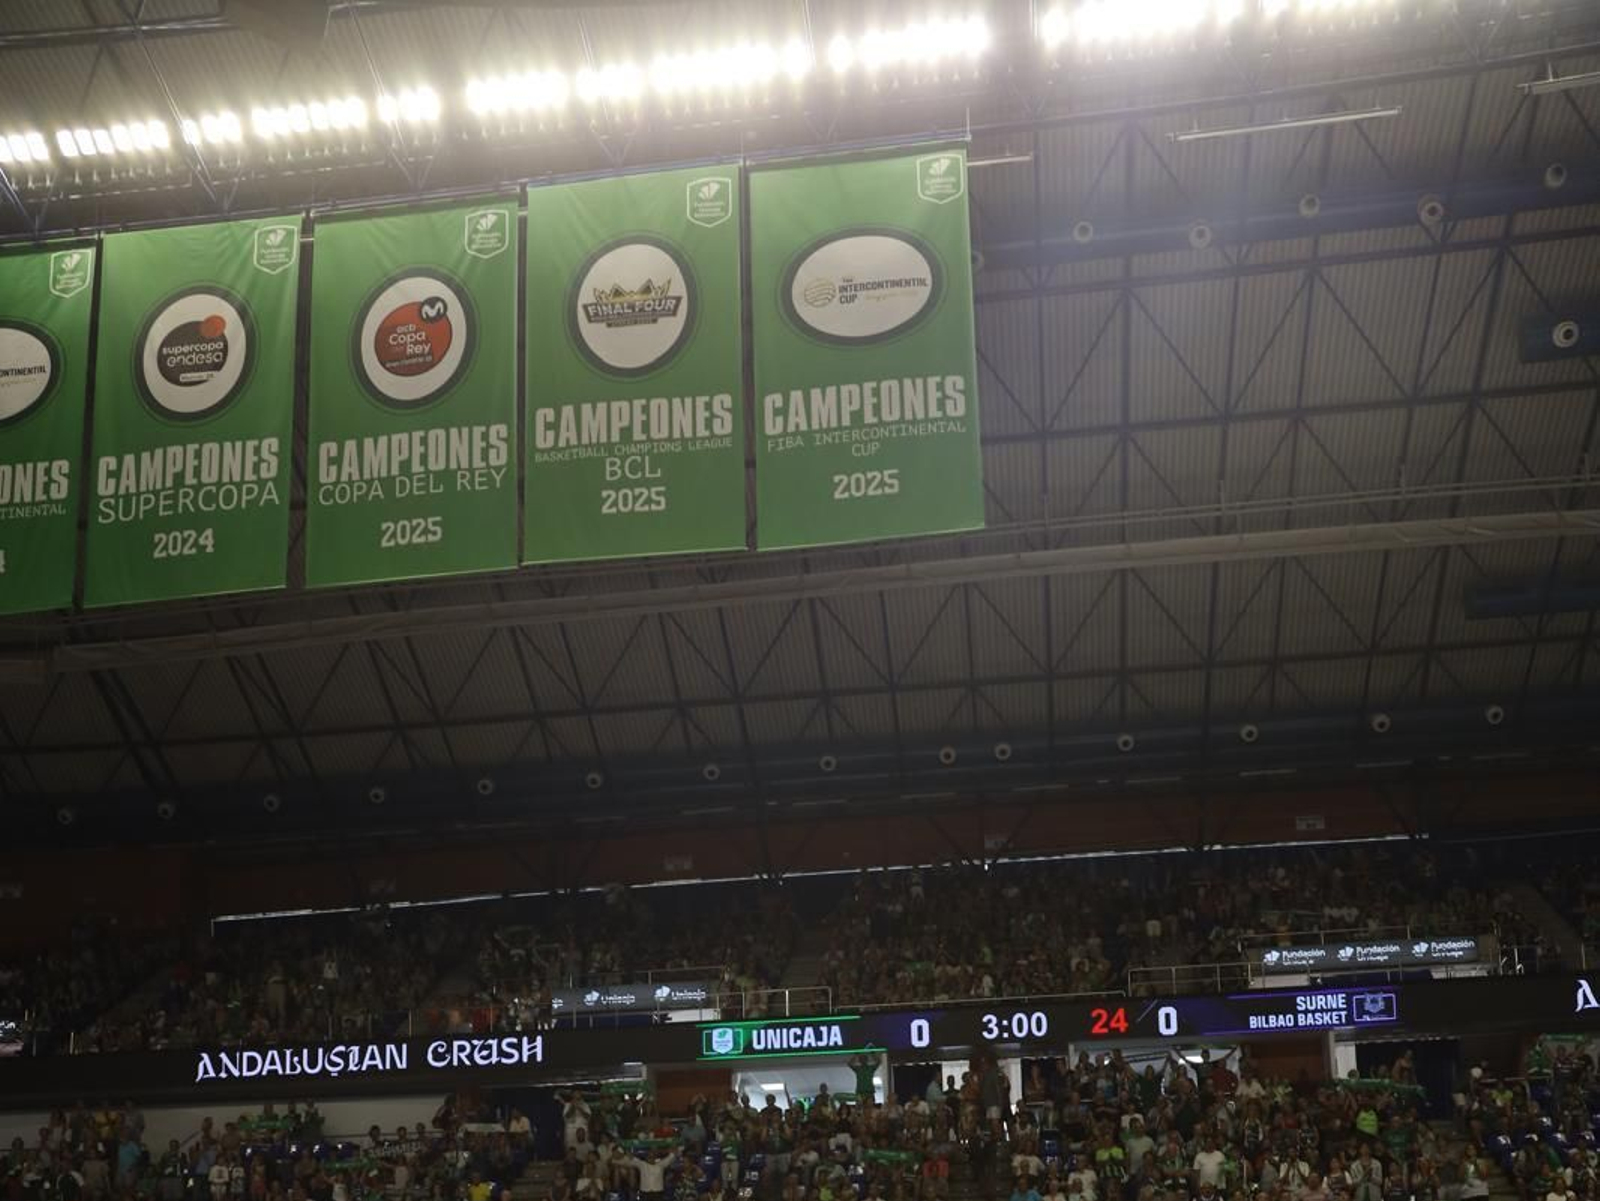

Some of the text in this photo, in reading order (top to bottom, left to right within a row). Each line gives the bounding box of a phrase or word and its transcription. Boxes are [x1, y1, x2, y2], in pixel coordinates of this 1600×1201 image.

[587, 298, 677, 317] FINAL FOUR
[162, 341, 225, 356] supercopa
[388, 331, 427, 346] Copa
[406, 342, 432, 356] Rey
[166, 351, 223, 368] endesa
[763, 374, 966, 436] CAMPEONES
[534, 393, 733, 450] CAMPEONES
[534, 436, 733, 463] BASKETBALL CHAMPIONS LEAGUE
[767, 420, 967, 453] FIBA INTERCONTINENTAL
[851, 442, 881, 458] CUP
[97, 437, 280, 497] CAMPEONES
[318, 423, 508, 484] CAMPEONES
[605, 455, 661, 481] BCL
[318, 467, 507, 505] COPA DEL REY
[833, 468, 900, 500] 2025
[98, 480, 280, 524] SUPERCOPA
[601, 486, 667, 514] 2025
[153, 528, 215, 559] 2024
[380, 516, 443, 548] 2025
[1296, 993, 1347, 1012] SURNE
[910, 1018, 930, 1048] 0
[981, 1011, 1048, 1040] 3:00
[1090, 1007, 1128, 1034] 24
[1157, 1006, 1178, 1036] 0
[1249, 1014, 1294, 1029] BILBAO
[1297, 1010, 1347, 1027] BASKET
[752, 1025, 843, 1050] UNICAJA
[195, 1034, 543, 1083] ANDALUSIAN CRUSH
